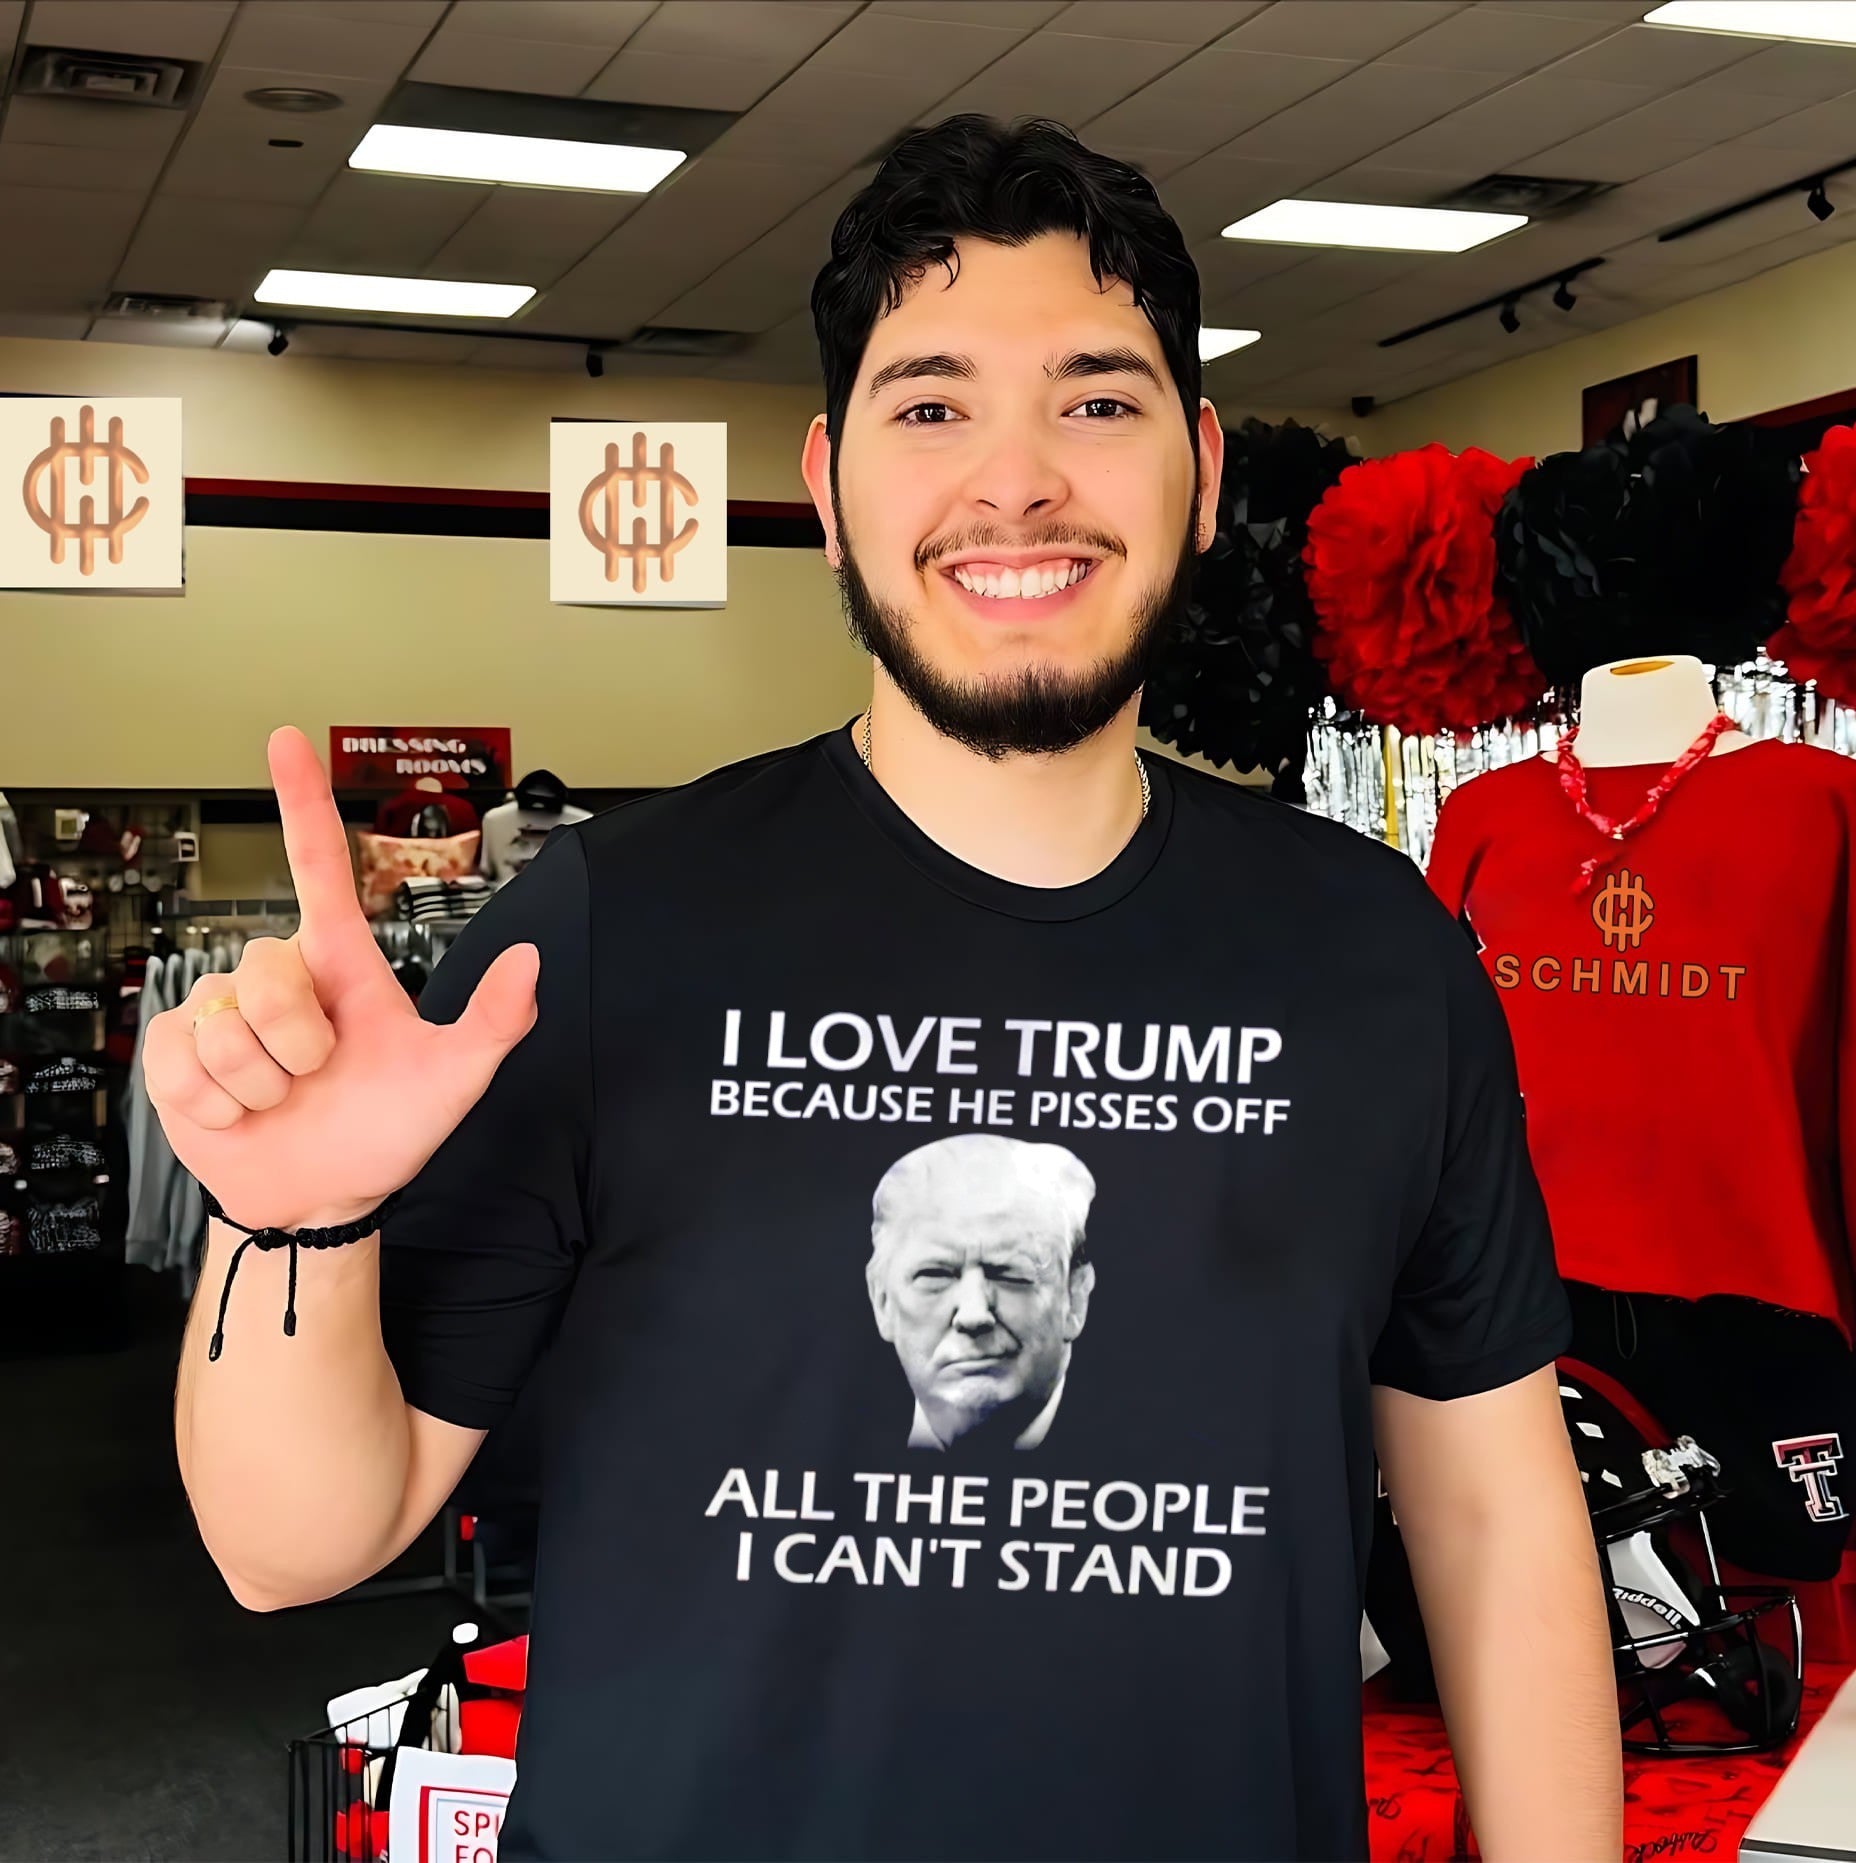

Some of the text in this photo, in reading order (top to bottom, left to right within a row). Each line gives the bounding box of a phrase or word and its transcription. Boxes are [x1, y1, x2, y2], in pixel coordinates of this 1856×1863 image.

[396, 757, 488, 775] ROOMS
[1494, 953, 1747, 1000] SCHMIDT
[722, 1008, 1283, 1083] I LOVE TRUMP
[710, 1079, 1292, 1135] BECAUSE HE PISSES OFF
[704, 1467, 1271, 1536] ALL THE PEOPLE
[736, 1531, 1233, 1597] I CAN'T STAND
